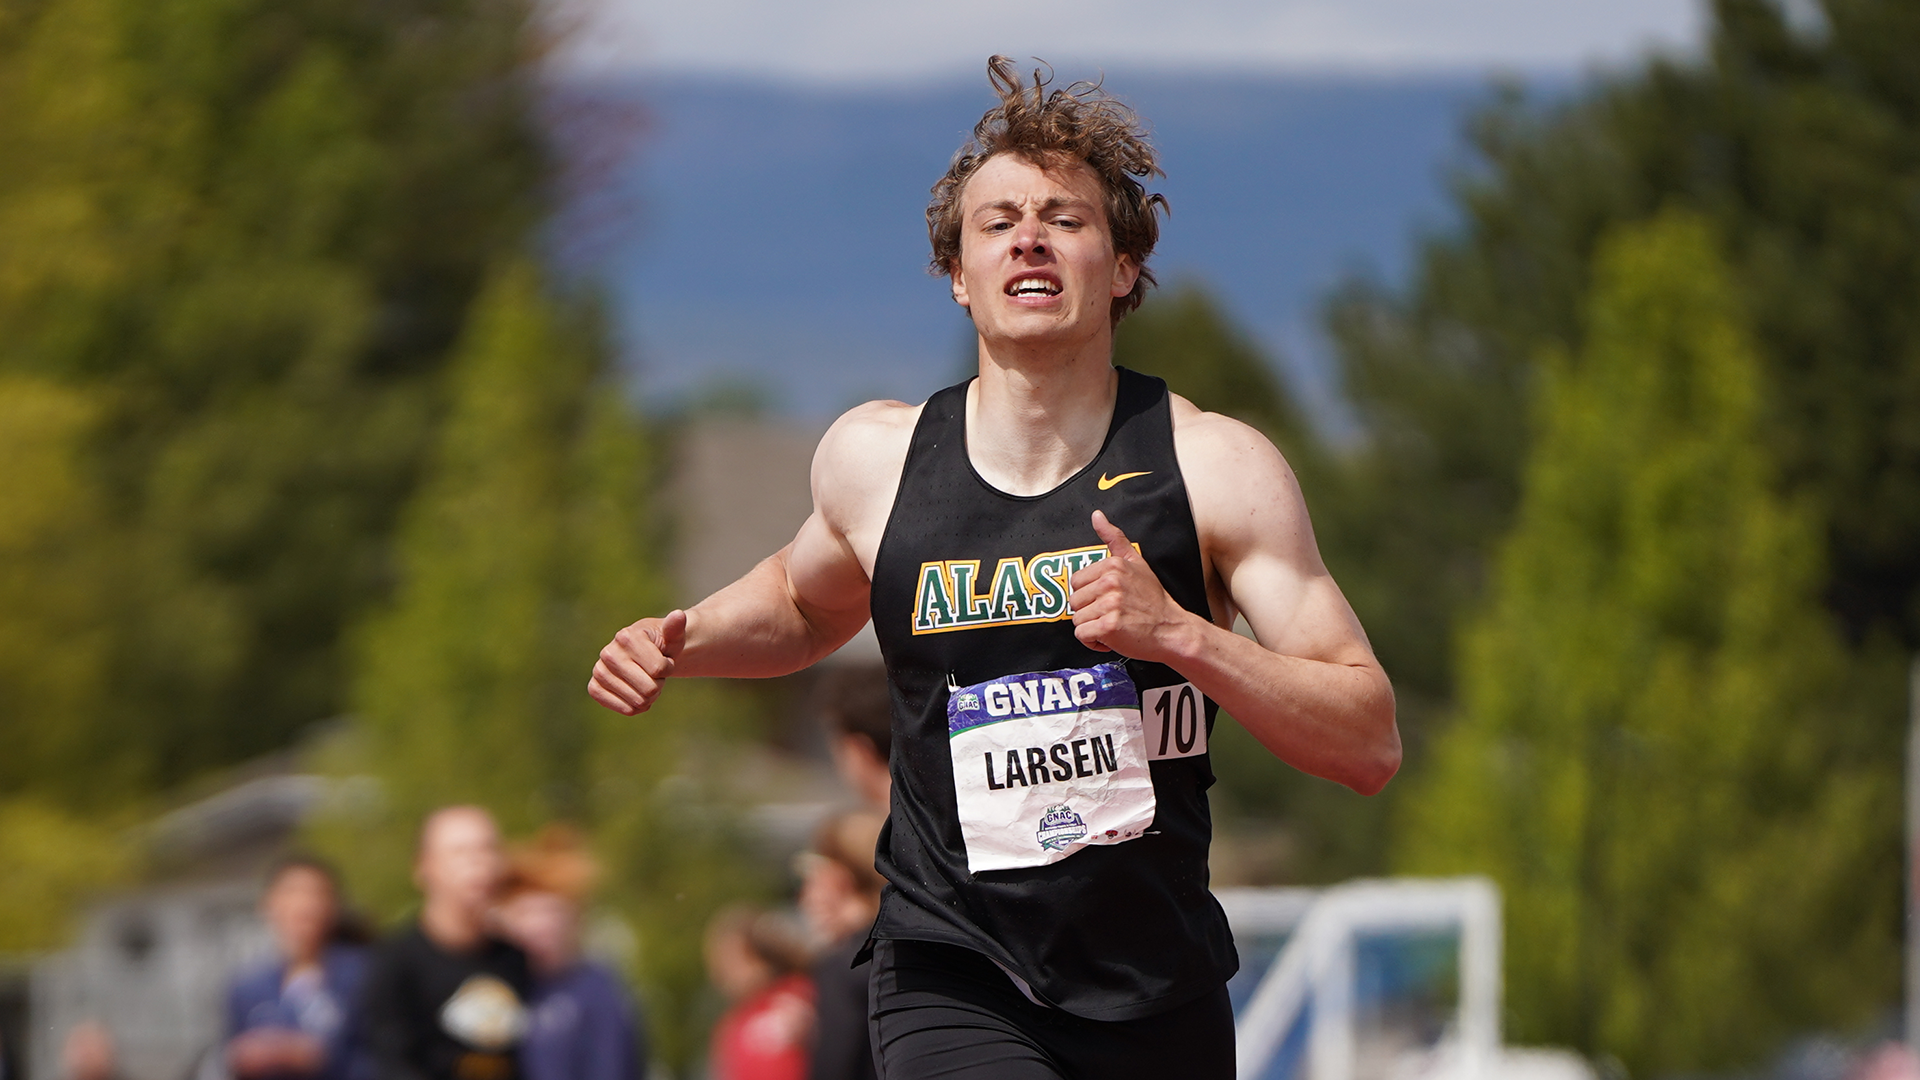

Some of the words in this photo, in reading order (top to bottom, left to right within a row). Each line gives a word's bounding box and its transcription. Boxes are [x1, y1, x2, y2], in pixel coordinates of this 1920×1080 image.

[912, 543, 1141, 635] ALAS
[984, 673, 1097, 717] GNAC
[1155, 685, 1197, 756] 10
[984, 734, 1118, 790] LARSEN
[1047, 810, 1072, 823] GNAC
